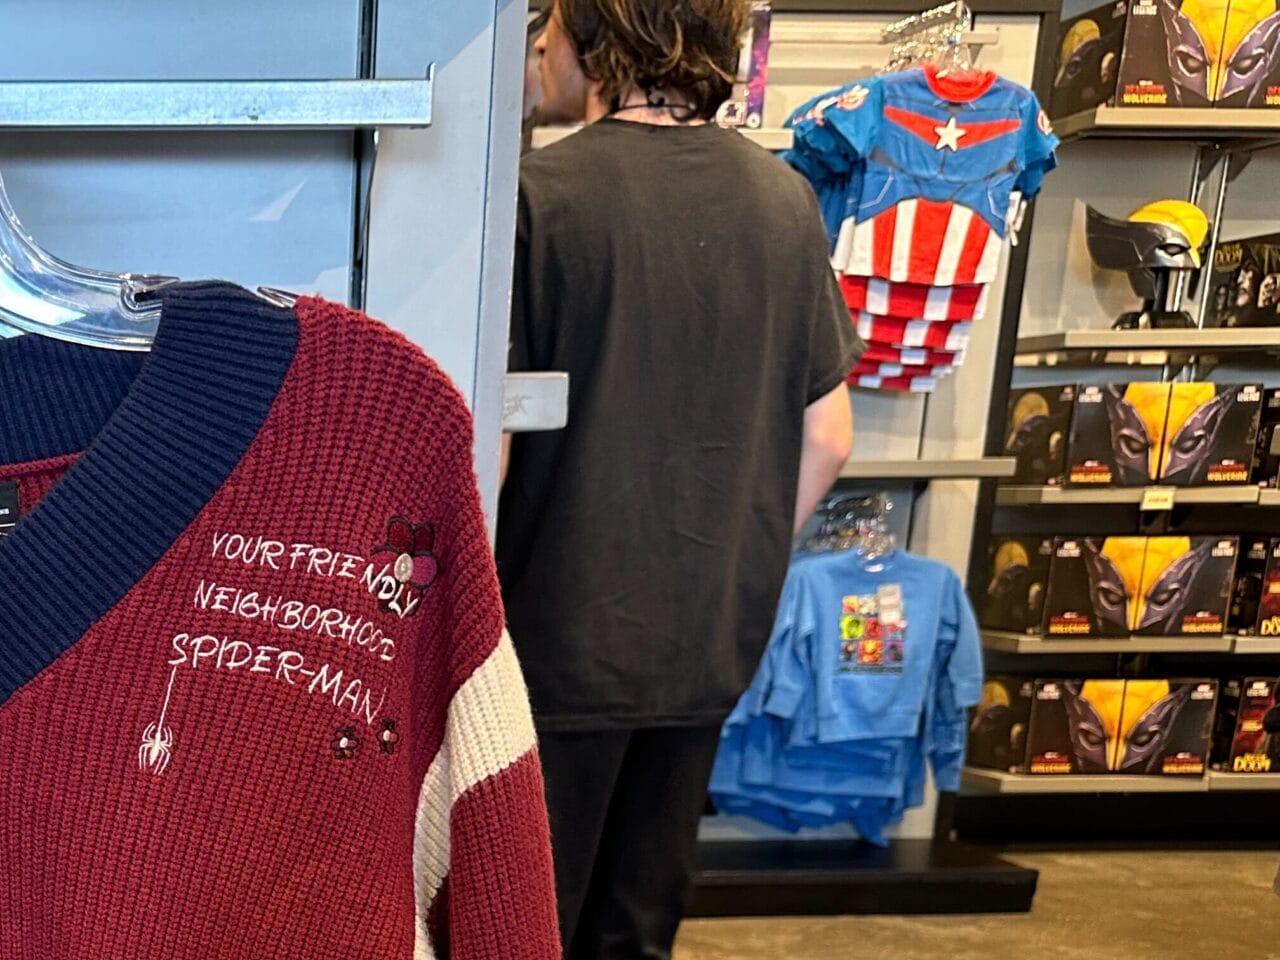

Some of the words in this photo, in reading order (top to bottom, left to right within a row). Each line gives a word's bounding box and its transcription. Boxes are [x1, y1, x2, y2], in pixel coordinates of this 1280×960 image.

[210, 532, 286, 570] YOUR
[289, 543, 420, 618] FRIENDLY
[193, 580, 397, 661] NEIGHBORHOOD
[168, 632, 388, 725] SPIDER-MAN
[1234, 756, 1271, 772] DOOM
